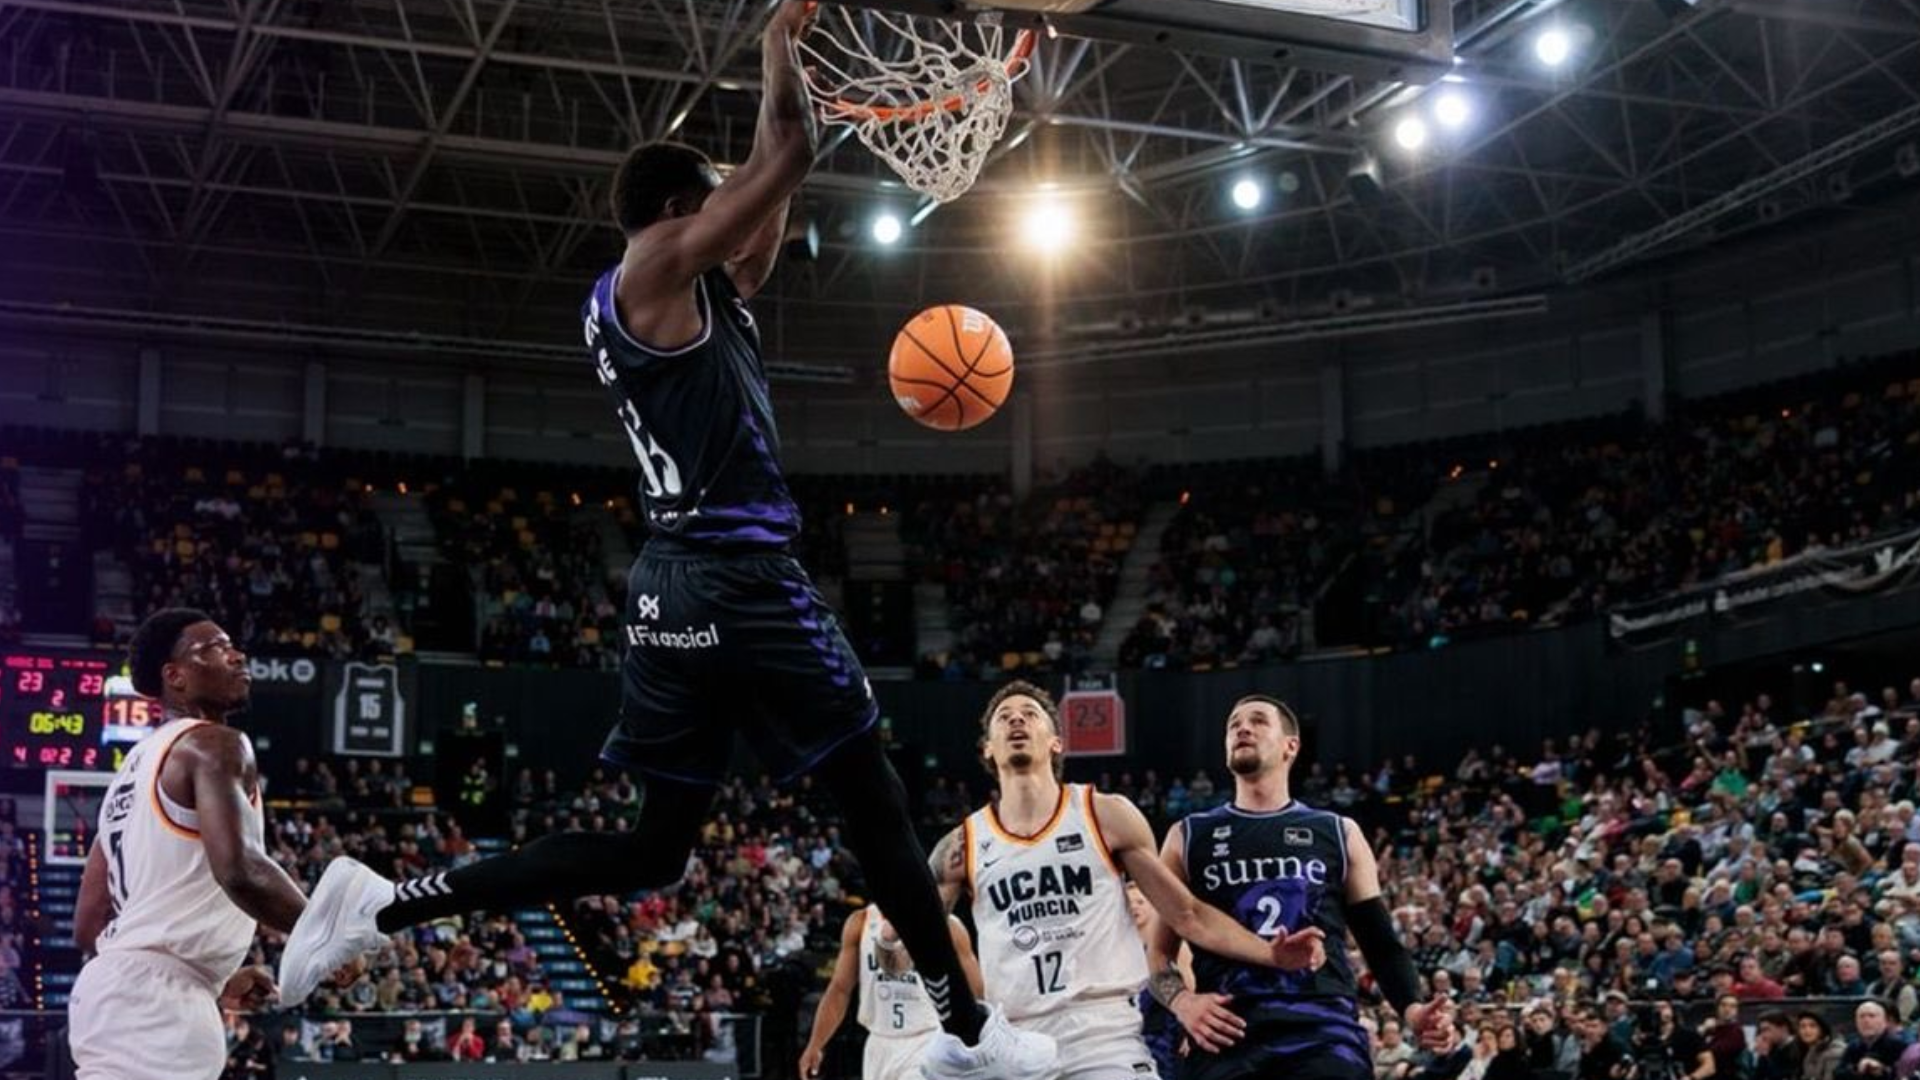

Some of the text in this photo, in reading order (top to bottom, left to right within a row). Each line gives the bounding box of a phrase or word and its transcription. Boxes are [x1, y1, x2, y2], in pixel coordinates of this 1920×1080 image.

[18, 671, 103, 694] 23 23
[360, 694, 381, 719] 15
[1075, 702, 1107, 727] 25
[1204, 855, 1327, 891] surne
[988, 864, 1093, 912] UCAM
[1007, 898, 1081, 927] MURCIA
[1256, 895, 1288, 935] 2
[1032, 950, 1066, 995] 12
[893, 1002, 904, 1029] 5
